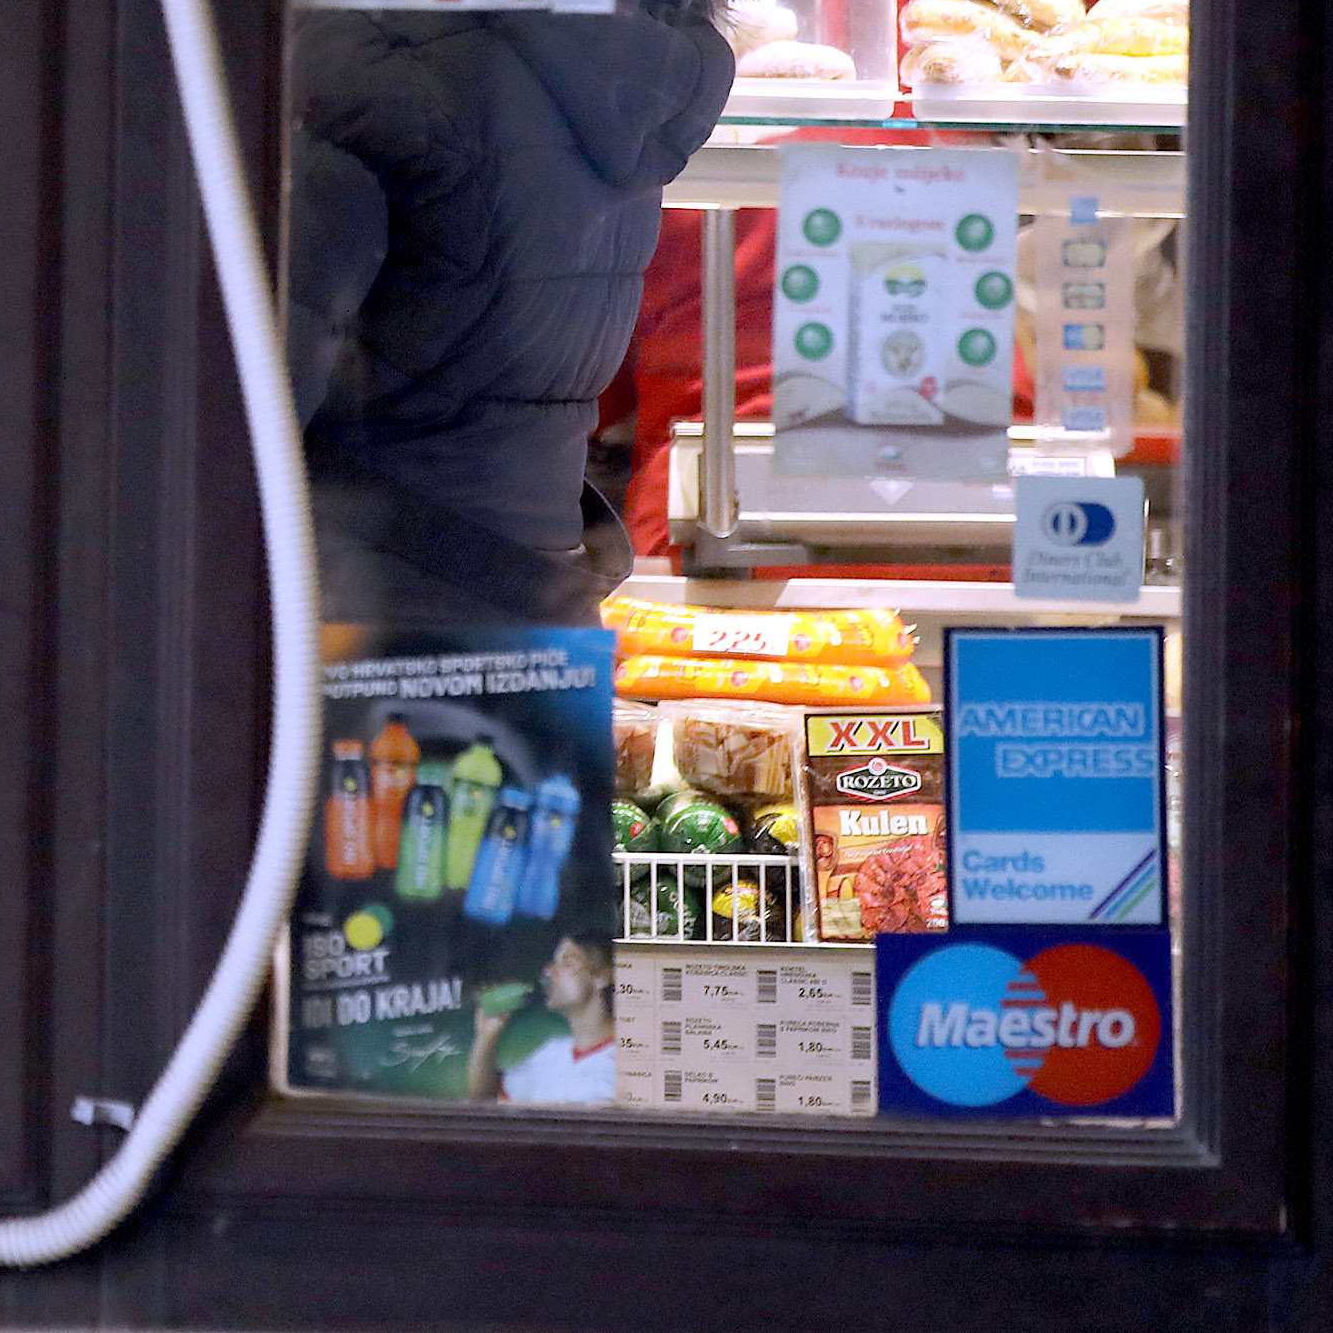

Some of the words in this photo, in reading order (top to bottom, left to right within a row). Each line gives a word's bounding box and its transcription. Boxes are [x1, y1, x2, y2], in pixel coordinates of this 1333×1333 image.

[894, 165, 967, 187] mlijeko
[1031, 550, 1076, 567] Diners
[1082, 549, 1123, 568] Club
[1023, 566, 1128, 589] International
[960, 702, 1145, 738] AMERICAN
[826, 719, 930, 752] XXL
[996, 743, 1156, 779] EXPRESS
[841, 774, 918, 790] ROZETO
[838, 809, 929, 837] Kulen
[961, 850, 1047, 876] Cards
[961, 877, 1096, 904] Welcome
[303, 945, 390, 981] SPORT
[336, 991, 372, 1027] DO
[374, 973, 464, 1021] KRAJA!
[703, 985, 729, 997] 7,75
[798, 987, 823, 999] 2,65
[916, 1002, 1136, 1050] Maestro
[702, 1039, 728, 1051] 5,45
[798, 1041, 823, 1053] 1,80
[702, 1093, 728, 1105] 4,90
[798, 1096, 822, 1108] 1,80
